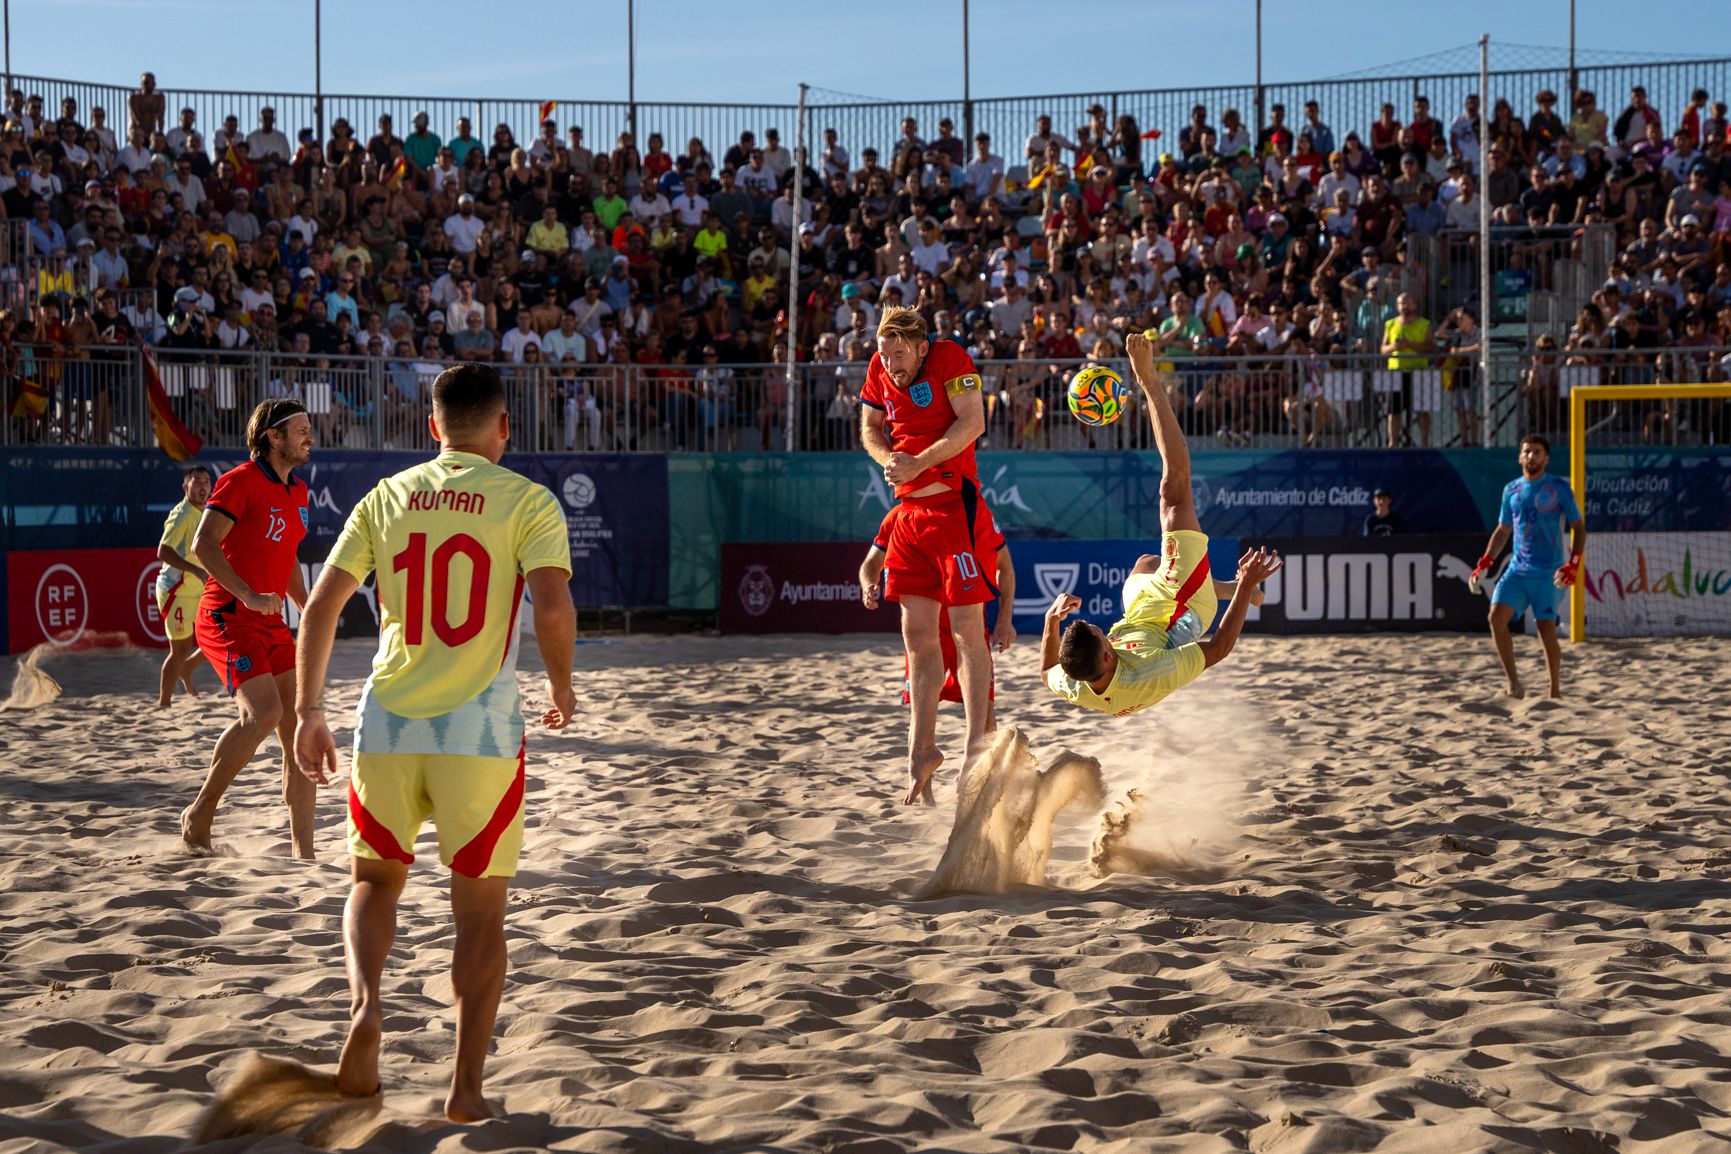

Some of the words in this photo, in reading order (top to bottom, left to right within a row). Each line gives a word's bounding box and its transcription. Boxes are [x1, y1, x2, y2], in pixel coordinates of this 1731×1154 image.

[962, 376, 975, 387] C
[1585, 474, 1669, 493] Diputación
[409, 489, 485, 515] KUMAN
[1215, 486, 1306, 509] Ayuntamiento
[1308, 486, 1327, 506] de
[1329, 485, 1371, 506] Cádiz
[1607, 497, 1651, 516] Cádiz
[265, 514, 286, 542] 12
[953, 552, 979, 580] 10
[393, 532, 491, 647] 10
[174, 607, 184, 624] 4
[1089, 594, 1113, 616] de
